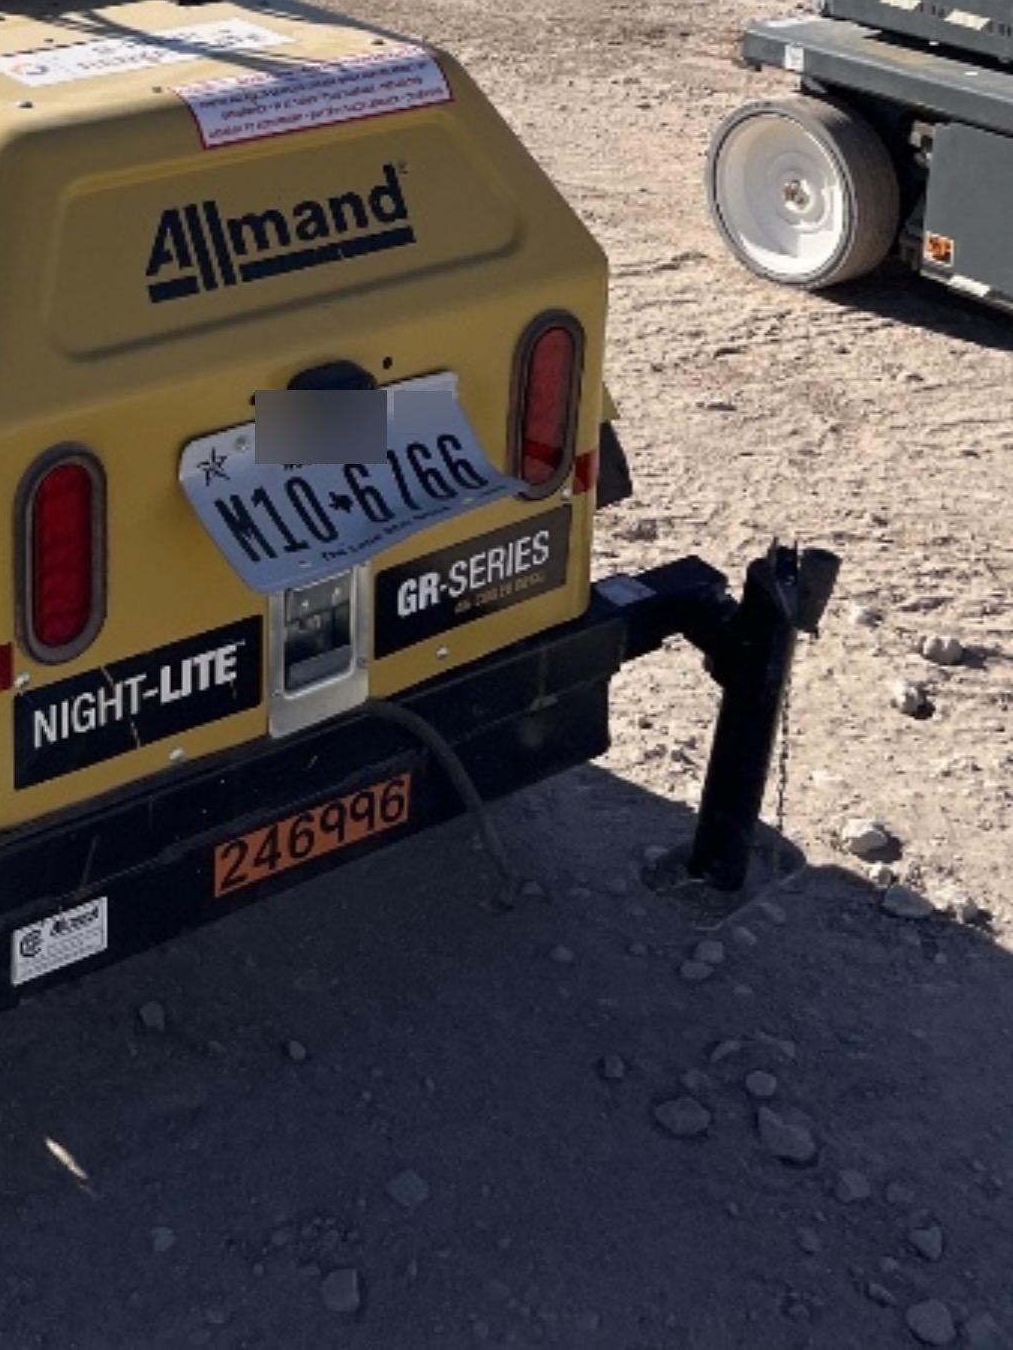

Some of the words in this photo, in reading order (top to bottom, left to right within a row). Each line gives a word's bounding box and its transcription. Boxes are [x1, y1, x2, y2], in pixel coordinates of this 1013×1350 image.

[145, 162, 408, 292] Allmand
[397, 530, 550, 618] GR-SERIES
[34, 644, 238, 748] NIGHT-LITE
[220, 779, 405, 891] 246996
